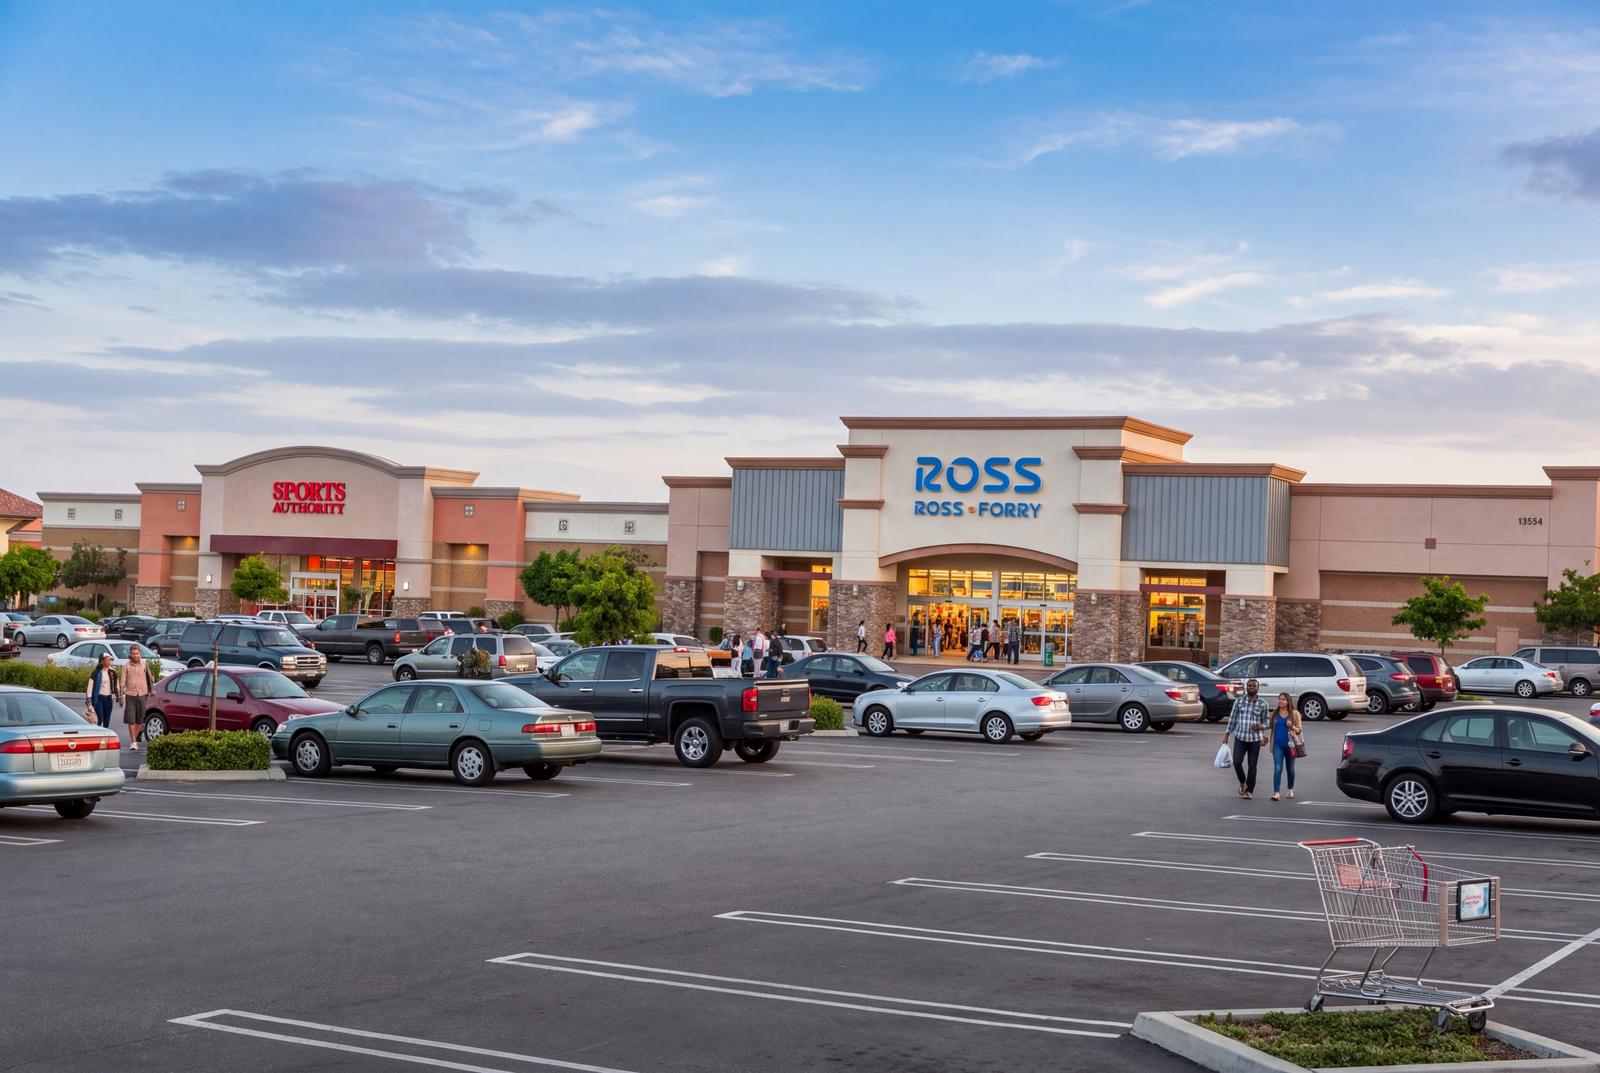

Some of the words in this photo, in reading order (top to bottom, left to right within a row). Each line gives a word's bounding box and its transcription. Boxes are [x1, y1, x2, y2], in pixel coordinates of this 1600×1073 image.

[914, 456, 1043, 494] ROSS
[272, 481, 346, 502] SPORTS
[272, 502, 346, 515] AUTHORITY
[914, 500, 964, 517] ROSS
[978, 502, 1042, 518] FORRY
[1518, 517, 1543, 526] 13554
